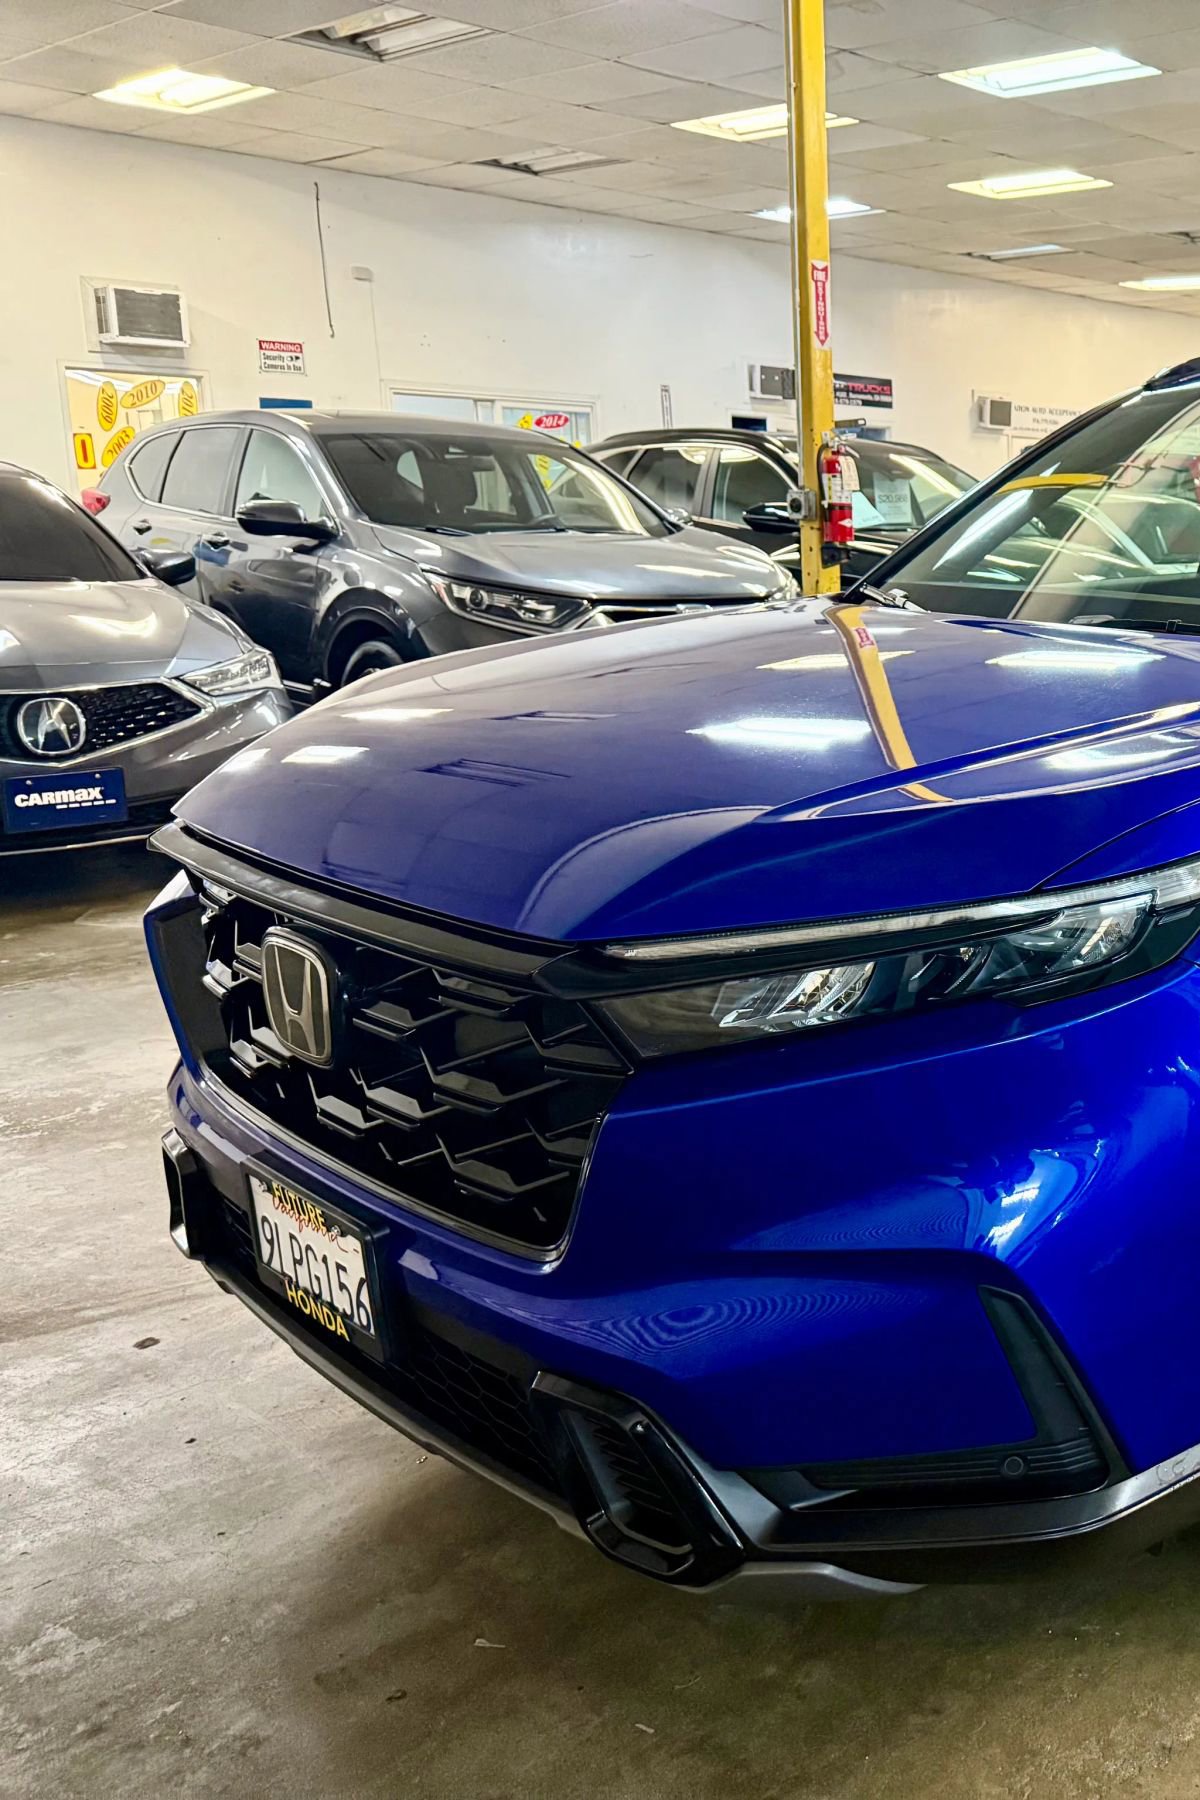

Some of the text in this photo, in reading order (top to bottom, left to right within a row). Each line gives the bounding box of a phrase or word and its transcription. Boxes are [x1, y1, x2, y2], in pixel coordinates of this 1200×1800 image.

[260, 341, 300, 352] WARNING
[263, 352, 285, 363] Security
[264, 361, 285, 370] Cameras
[128, 381, 158, 406] 2010
[847, 382, 891, 395] TRUCKS
[101, 387, 115, 424] 2009
[540, 415, 565, 428] 2014
[272, 1181, 327, 1230] FUTURE
[261, 1215, 372, 1334] 9LPG156
[284, 1276, 351, 1342] HONDA
